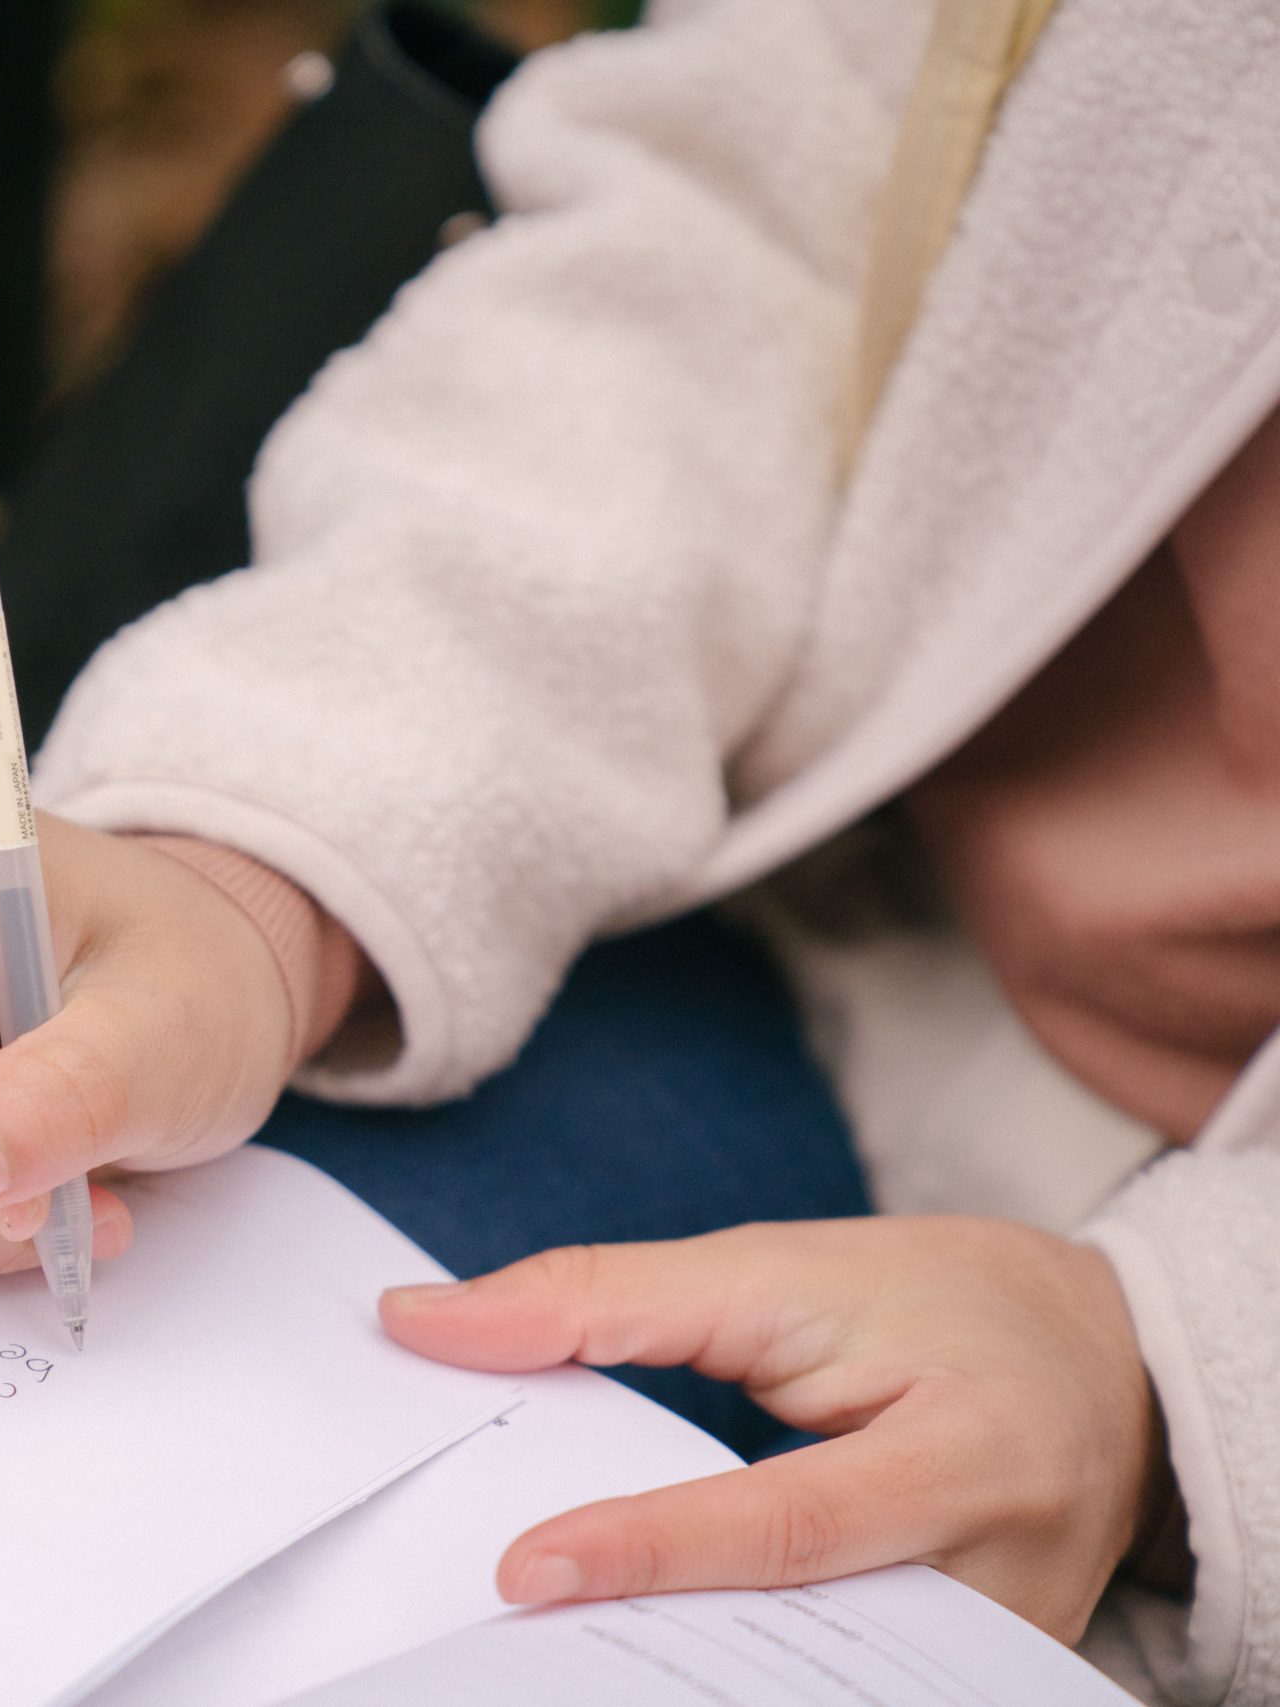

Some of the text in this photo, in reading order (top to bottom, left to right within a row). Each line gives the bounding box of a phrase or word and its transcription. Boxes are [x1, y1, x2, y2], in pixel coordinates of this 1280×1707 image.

[10, 762, 22, 795] JAPAN
[16, 797, 24, 808] IN
[17, 810, 30, 840] MADE
